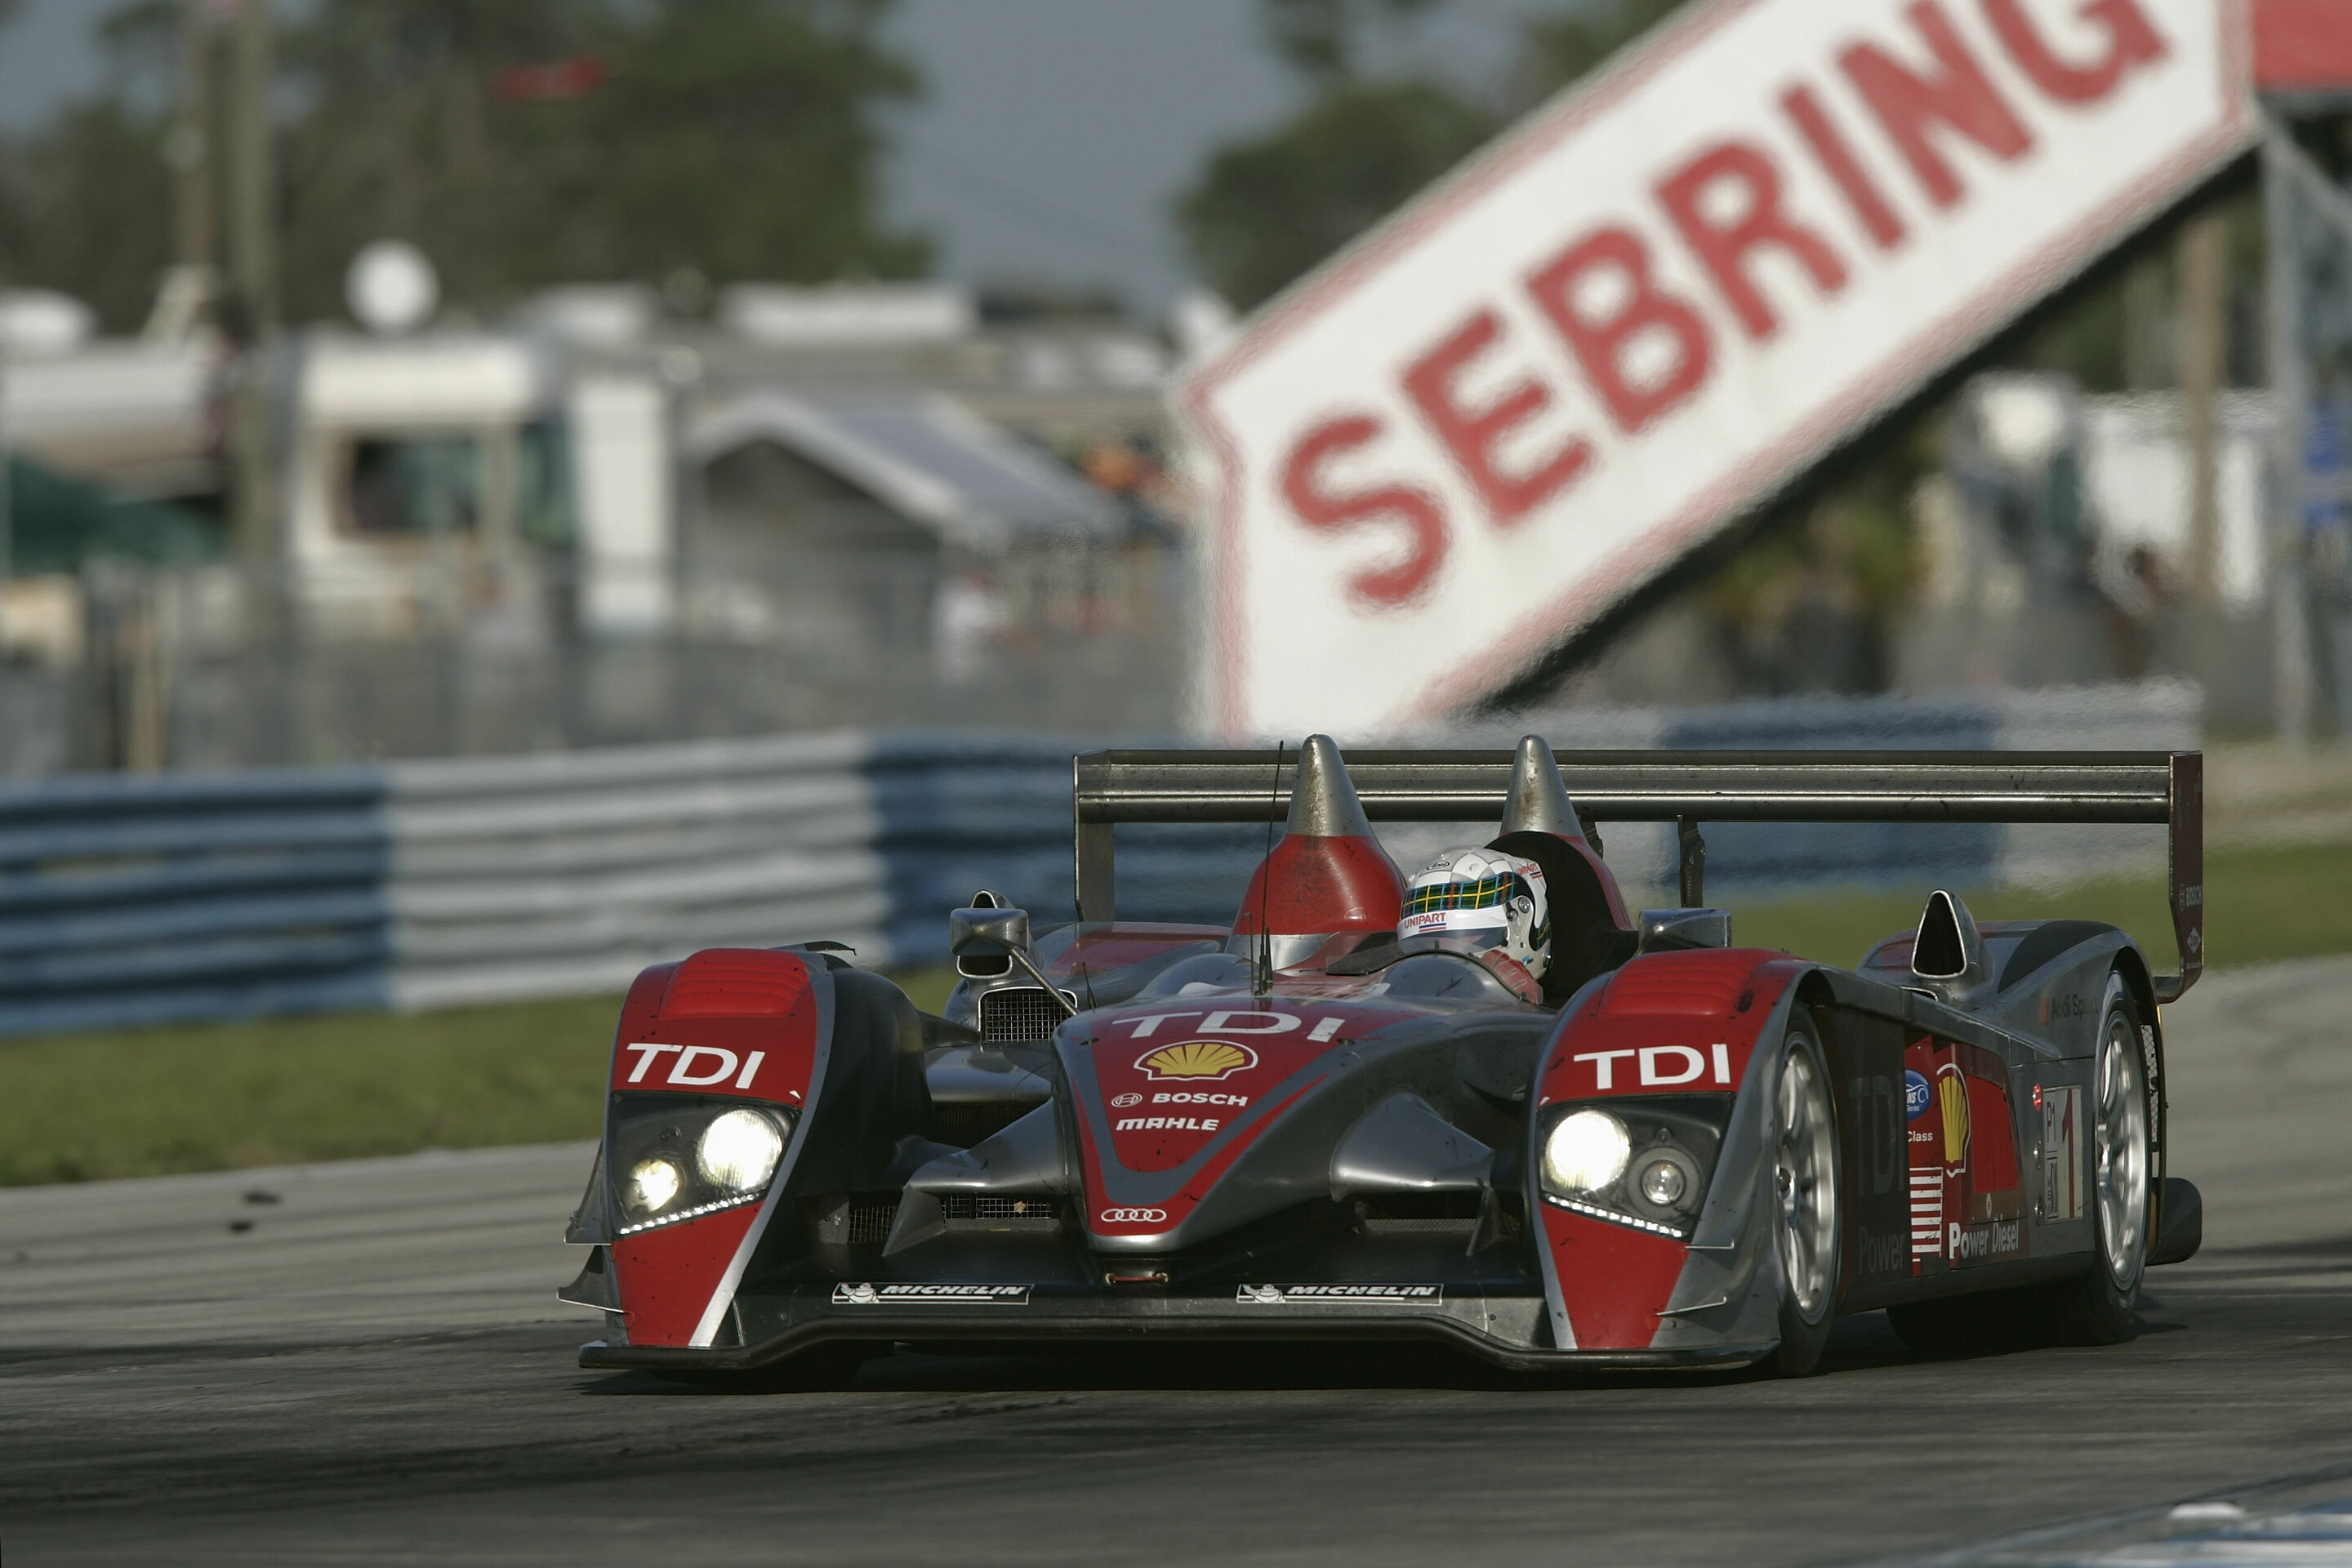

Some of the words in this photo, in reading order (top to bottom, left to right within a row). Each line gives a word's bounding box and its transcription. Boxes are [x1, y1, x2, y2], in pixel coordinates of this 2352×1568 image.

[1277, 0, 2172, 611] SEBRING
[1404, 912, 1446, 929] UNIPART
[1111, 1010, 1345, 1043] TDI
[2051, 993, 2072, 1019] Audi
[627, 1042, 766, 1089] TDI
[1574, 1044, 1731, 1089] TDI
[1152, 1092, 1249, 1107] BOSCH
[1116, 1117, 1219, 1131] MAHLE
[1848, 1071, 1904, 1197] TDI
[2046, 1101, 2056, 1143] P1
[2062, 1088, 2075, 1218] 1
[1858, 1225, 1905, 1275] Power
[1949, 1223, 1989, 1259] Power
[1992, 1210, 2020, 1253] Diesel
[881, 1285, 1027, 1295] MICHELIN
[1286, 1285, 1437, 1296] MICHELIN
